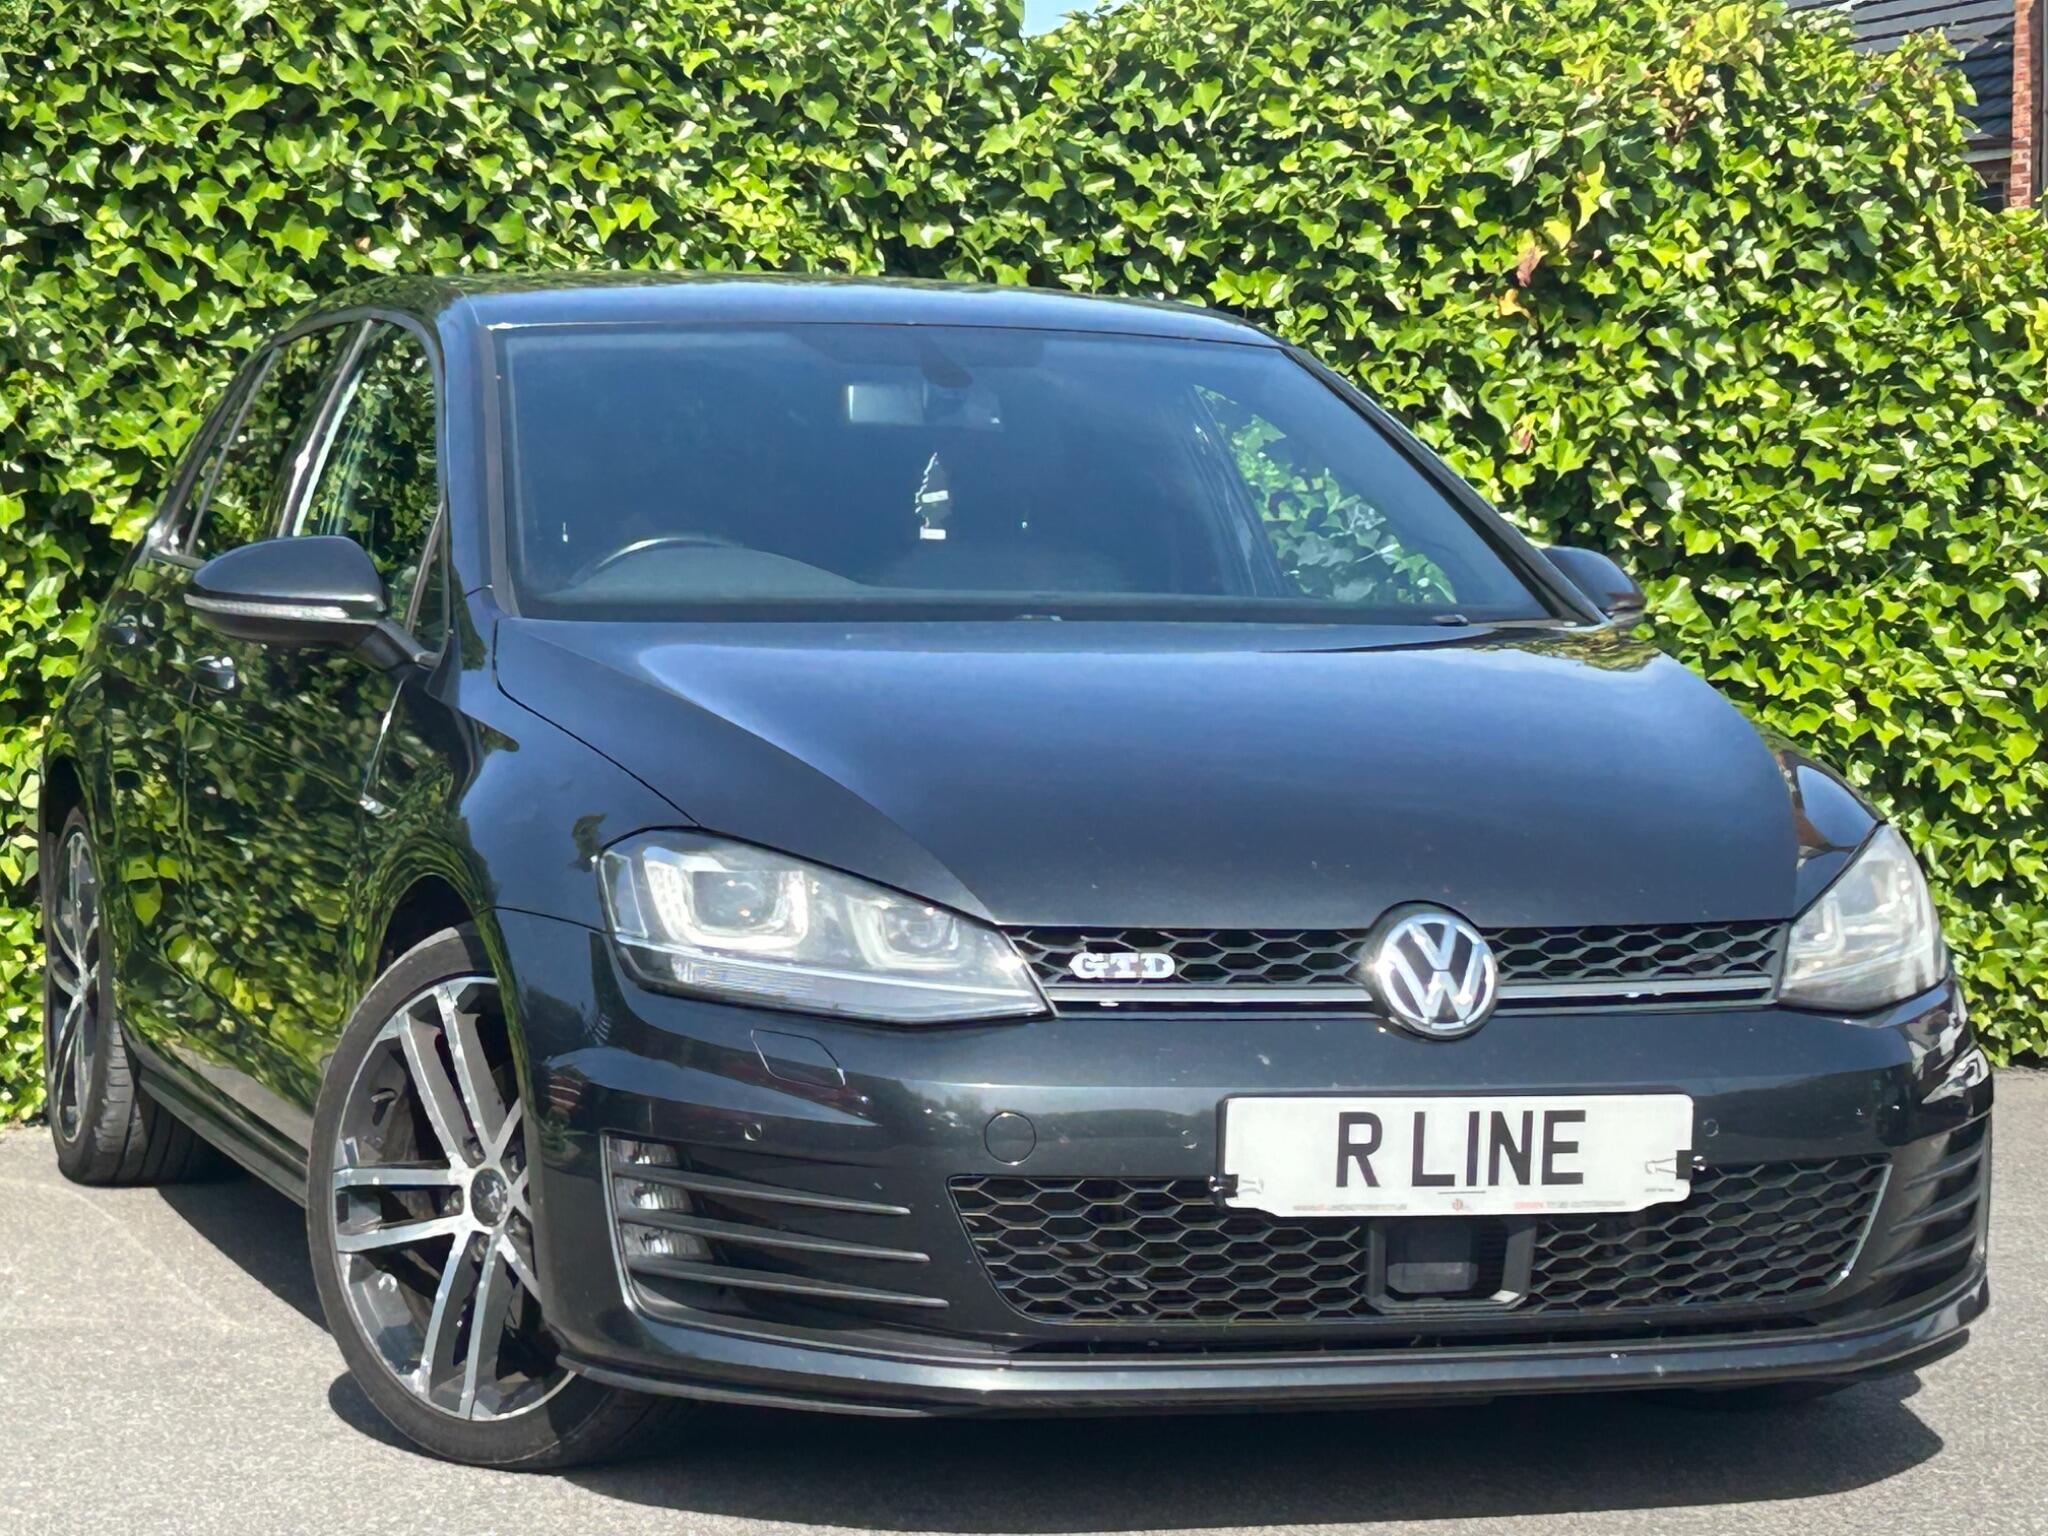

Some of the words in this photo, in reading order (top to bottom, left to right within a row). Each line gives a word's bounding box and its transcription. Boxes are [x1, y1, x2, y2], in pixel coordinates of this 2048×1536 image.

[1069, 952, 1175, 979] GTD
[1336, 1111, 1383, 1188] R
[1411, 1110, 1586, 1187] LINE
